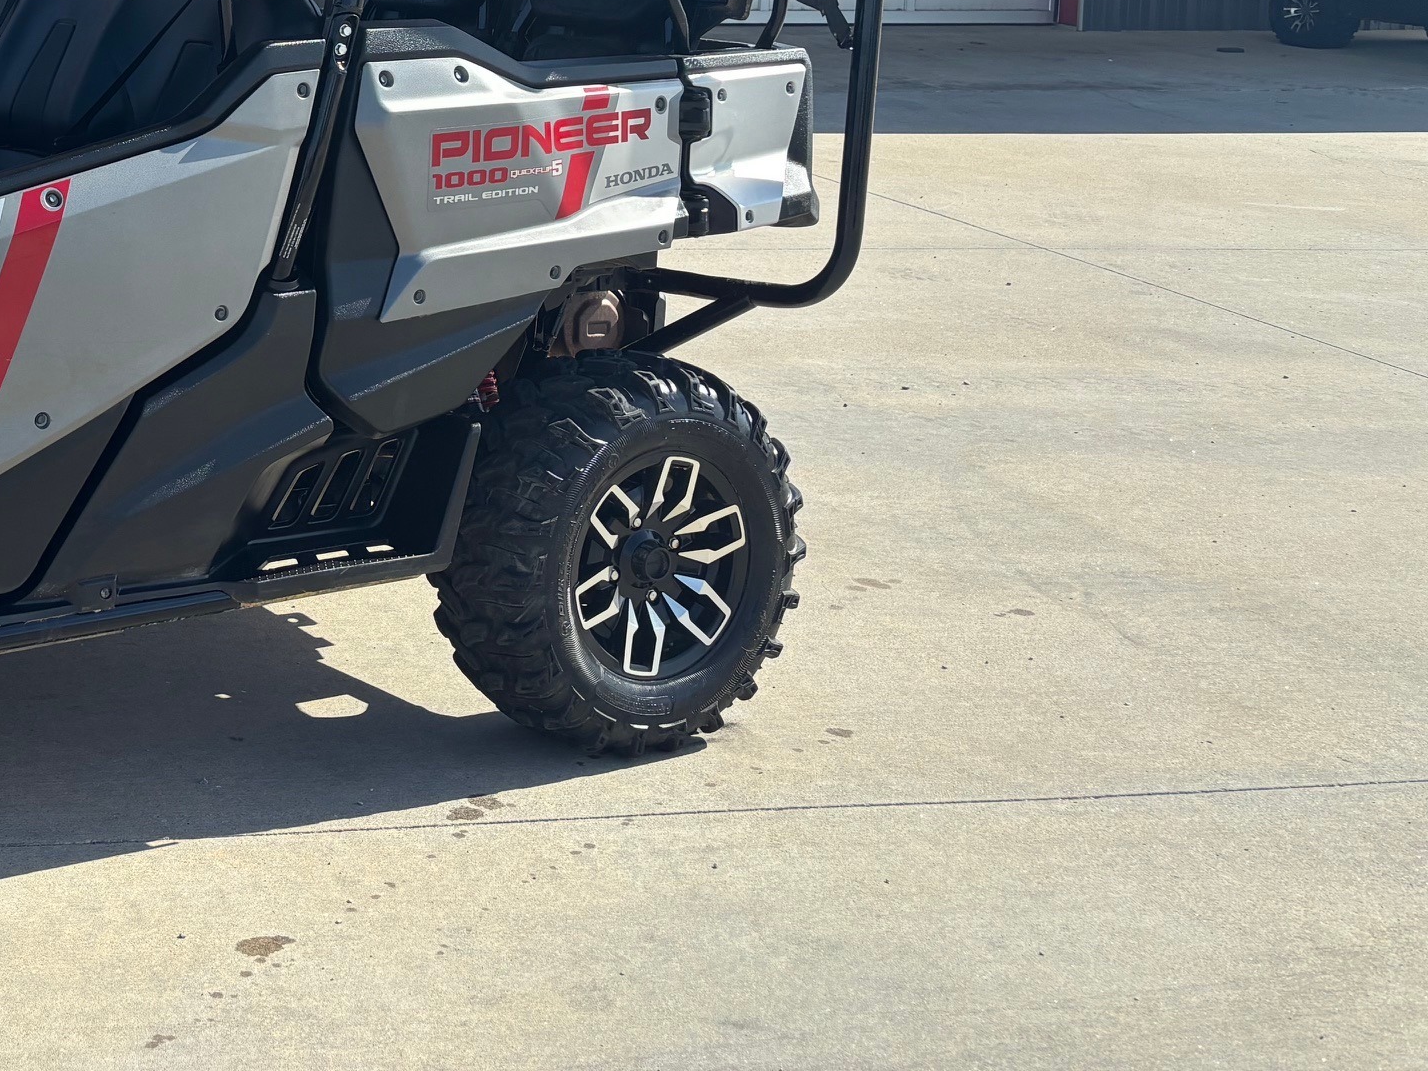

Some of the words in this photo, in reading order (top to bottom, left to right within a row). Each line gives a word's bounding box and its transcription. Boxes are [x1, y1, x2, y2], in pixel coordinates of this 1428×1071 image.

[432, 109, 651, 167] PIONEER
[432, 167, 507, 189] 1000
[604, 162, 674, 189] HONDA
[433, 190, 478, 205] TRAIL
[482, 185, 539, 199] EDITION
